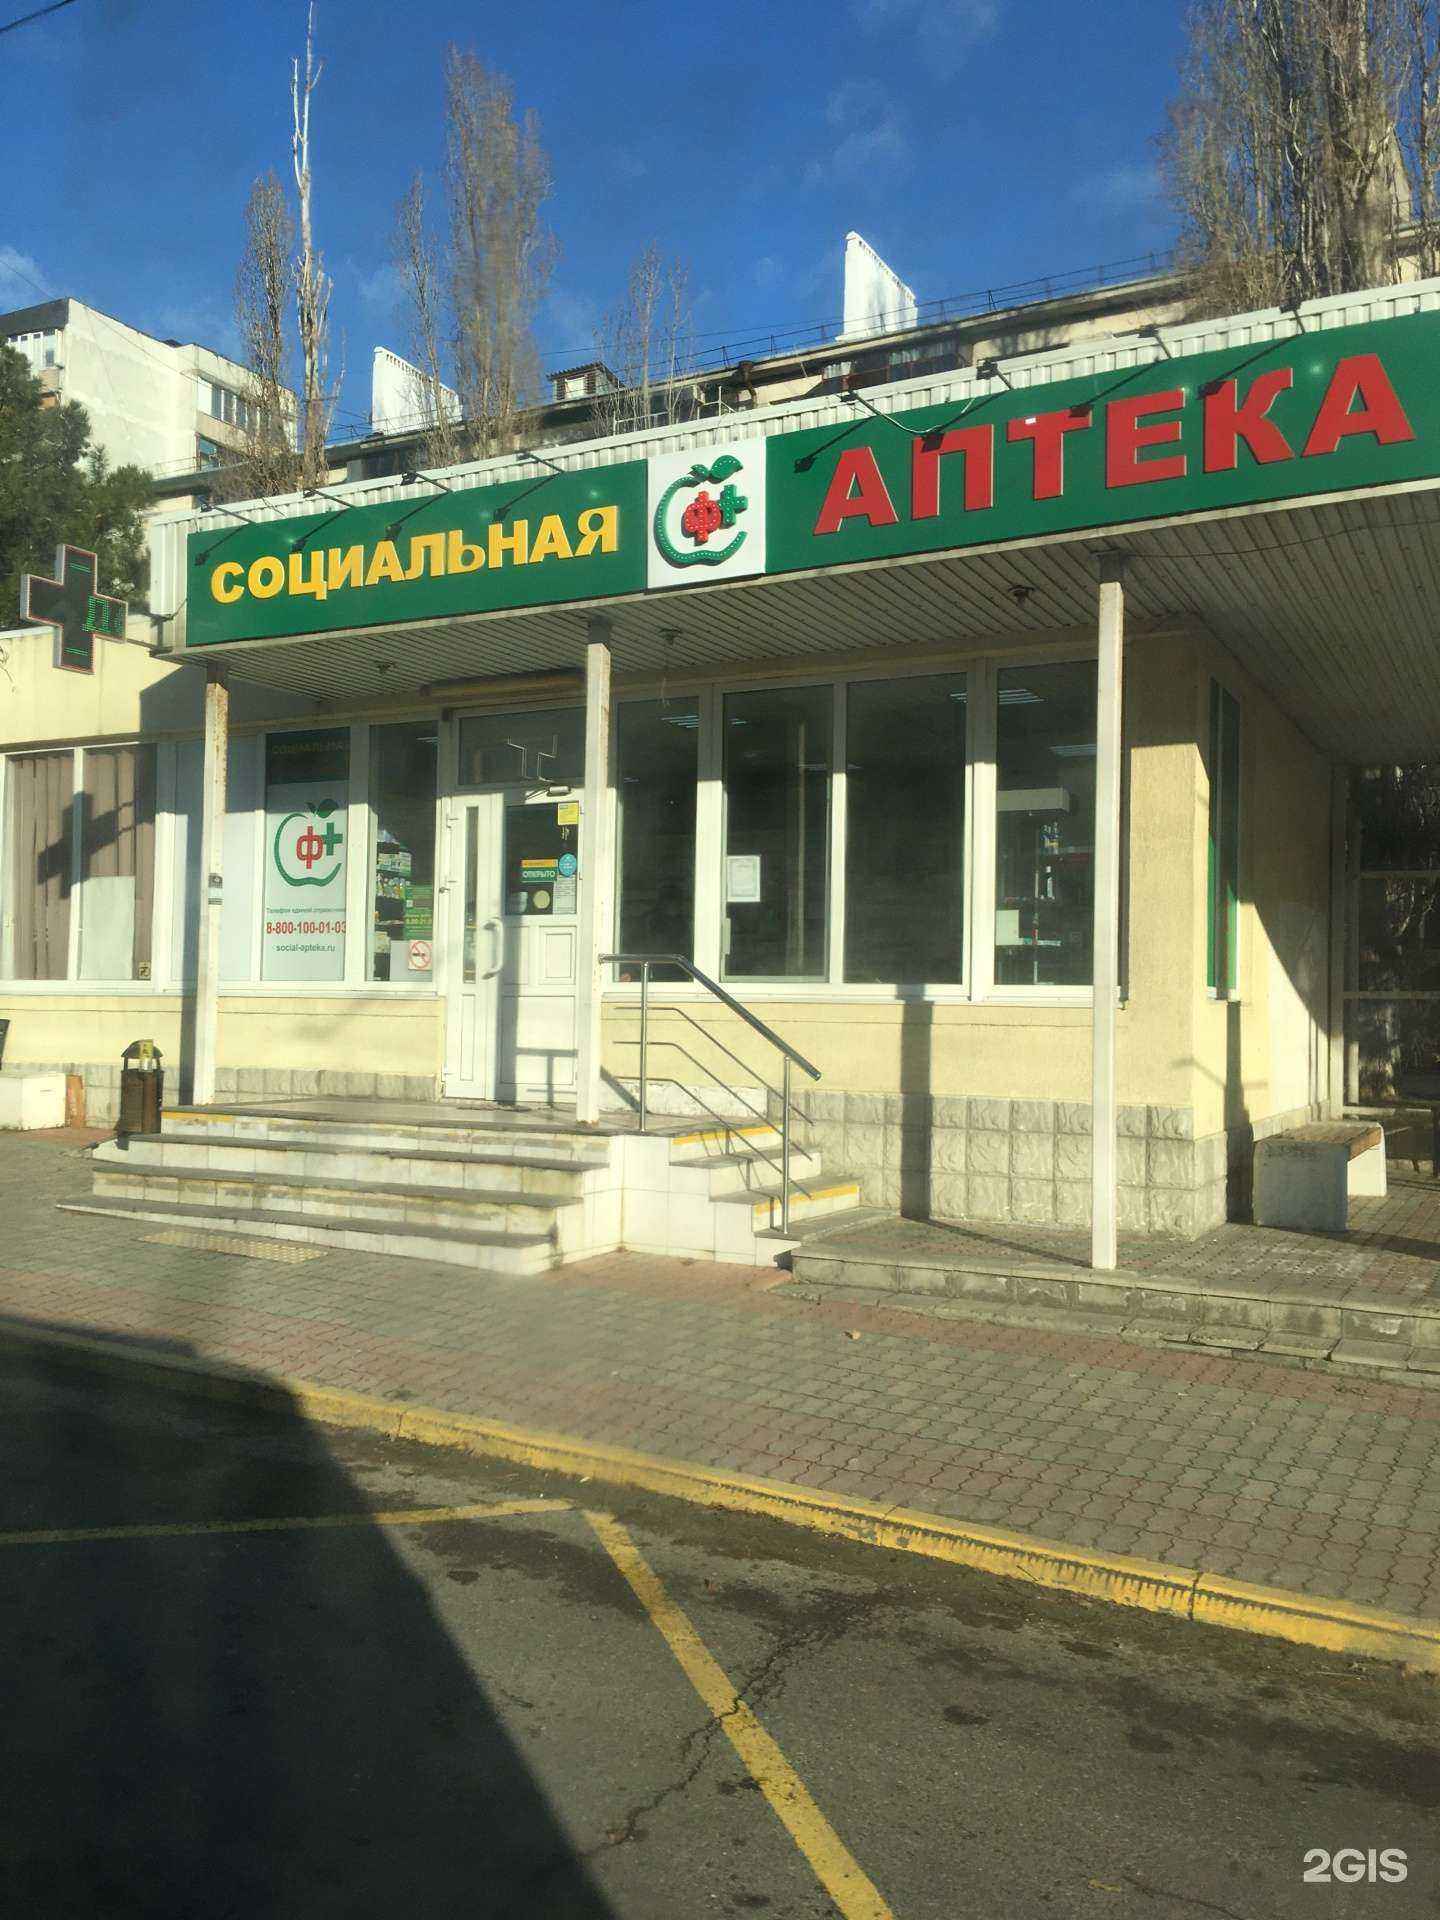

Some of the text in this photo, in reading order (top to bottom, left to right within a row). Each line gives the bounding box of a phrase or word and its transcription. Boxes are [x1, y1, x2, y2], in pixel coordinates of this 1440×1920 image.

[813, 352, 1416, 536] АПТЕКА
[210, 505, 620, 604] СОЦИАЛЬНАЯ
[266, 921, 346, 934] 8-800-100-01-03
